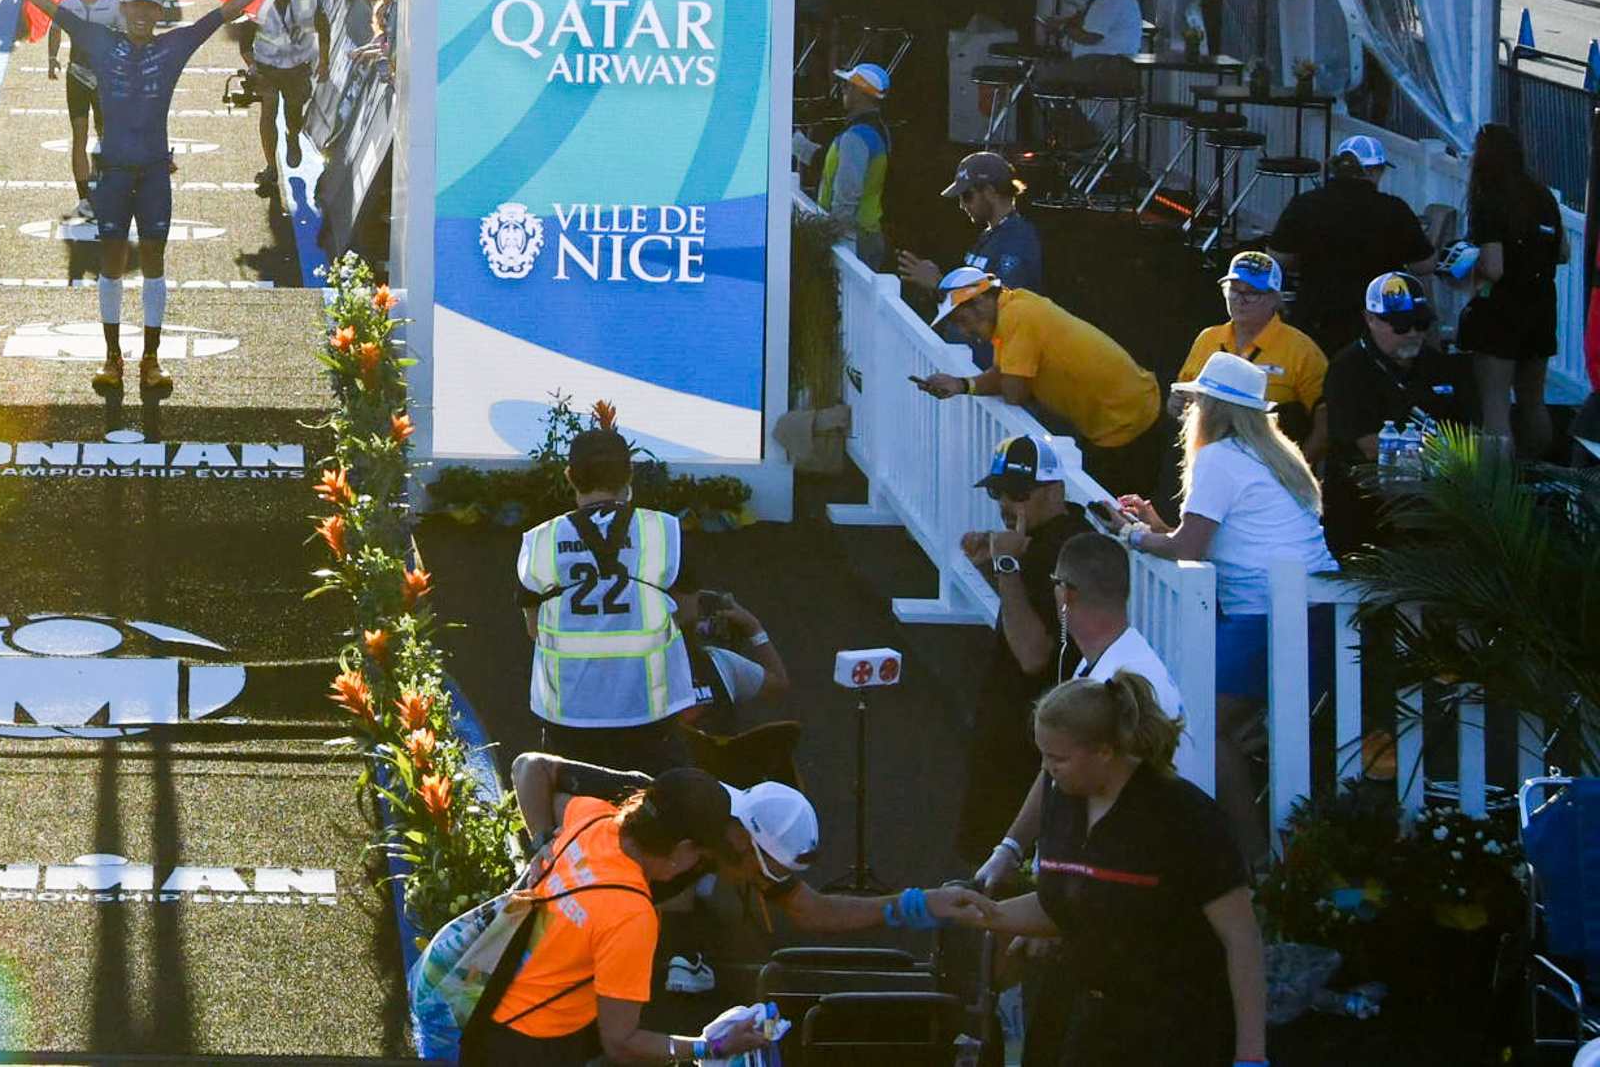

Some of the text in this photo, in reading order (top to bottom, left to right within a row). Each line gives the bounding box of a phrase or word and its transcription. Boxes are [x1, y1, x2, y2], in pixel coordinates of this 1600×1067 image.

[547, 54, 716, 87] AIRWAYS
[551, 203, 706, 234] VILLE DE
[552, 234, 706, 283] NICE
[195, 468, 306, 480] EVENTS
[569, 562, 630, 616] 22
[187, 892, 338, 906] EVENTS
